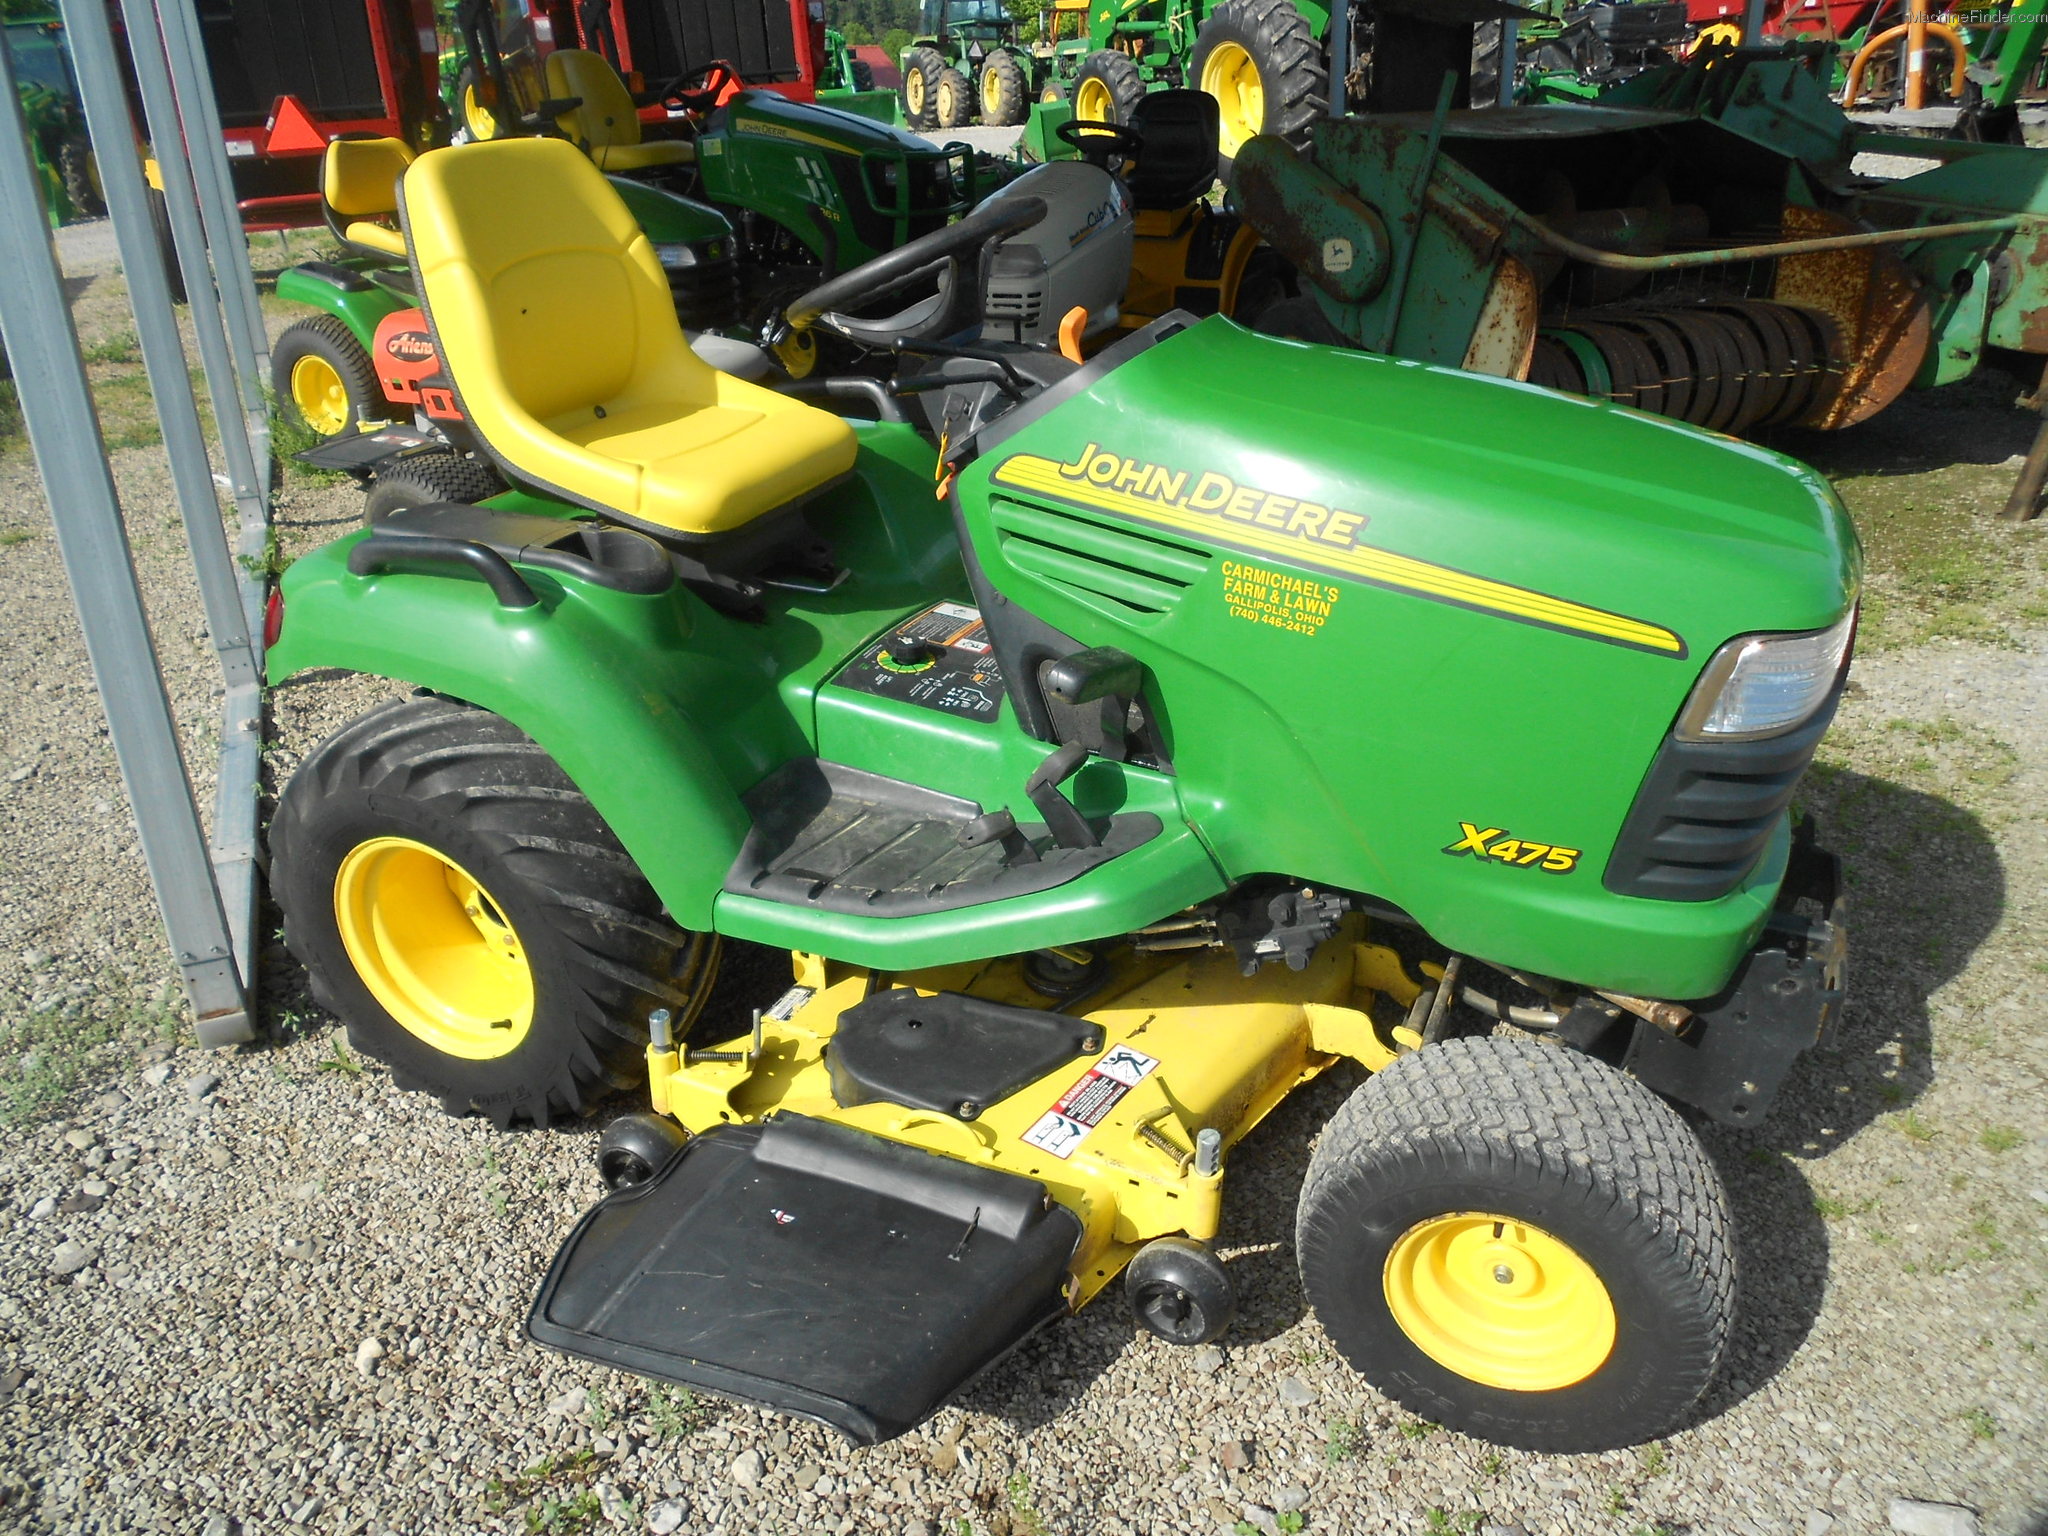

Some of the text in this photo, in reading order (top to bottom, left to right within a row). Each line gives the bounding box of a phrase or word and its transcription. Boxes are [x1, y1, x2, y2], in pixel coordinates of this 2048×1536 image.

[1060, 443, 1366, 547] JOHN DEERE
[1221, 560, 1339, 603] CARMICHAEL'S
[1223, 576, 1331, 617] FARM & LAWN
[1224, 593, 1325, 627] GALLIPOLIS, OHIO
[1230, 605, 1316, 637] (740) 446-2412
[1442, 821, 1581, 874] X475
[1064, 1074, 1095, 1101] DANGER
